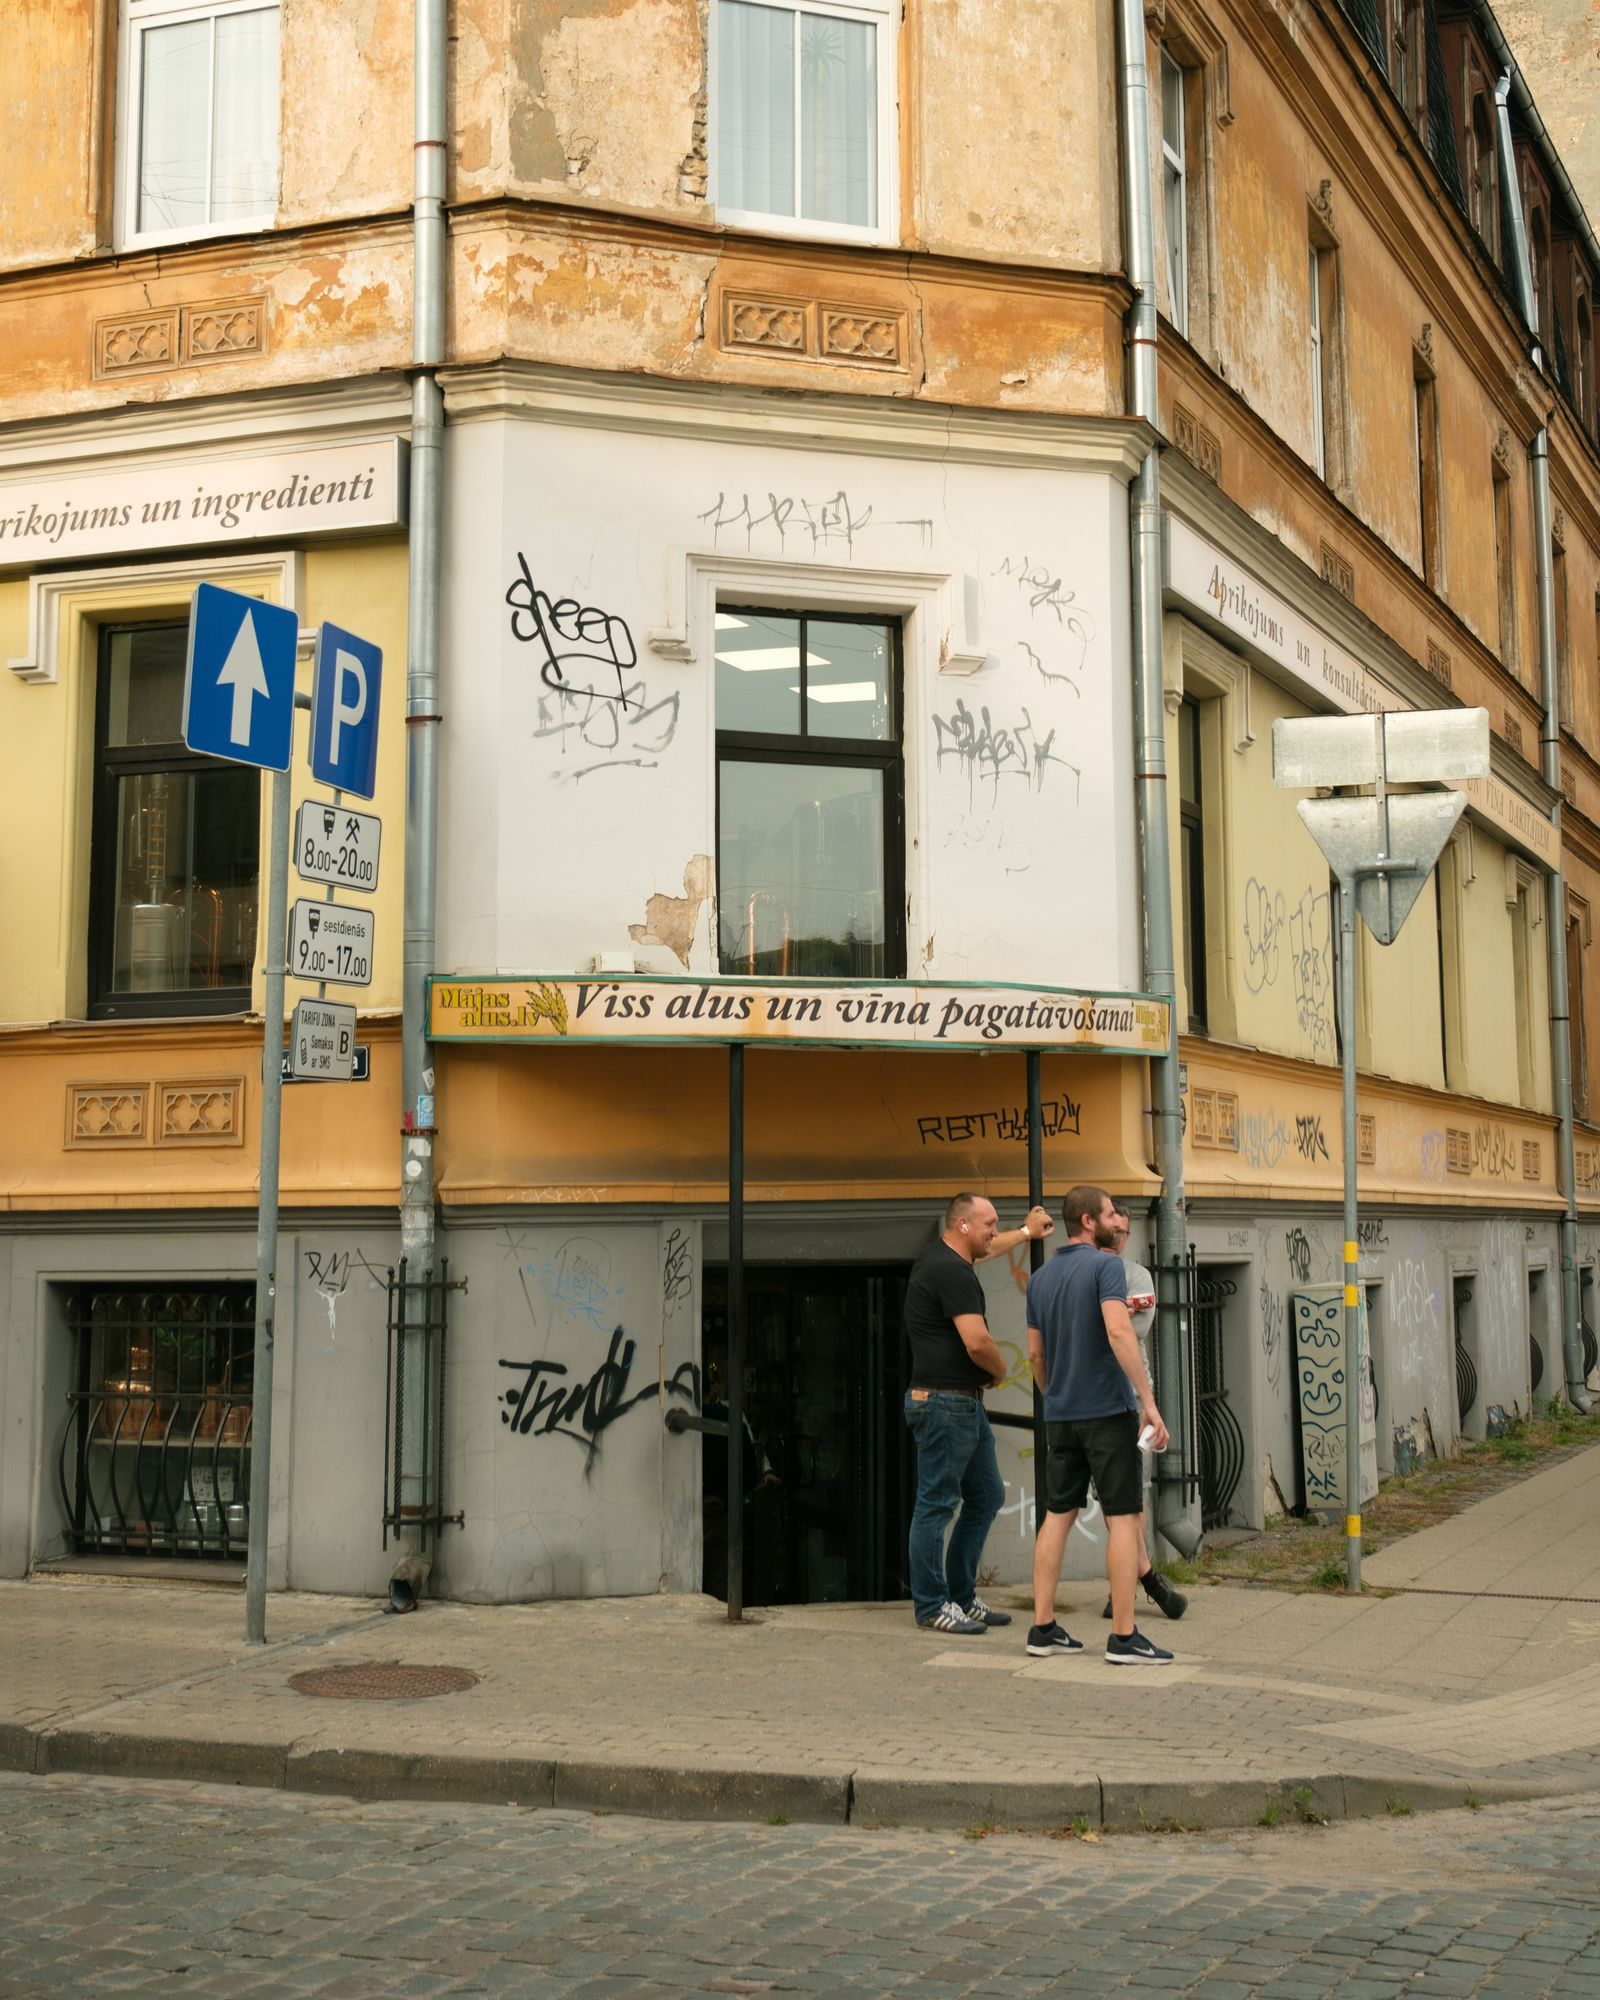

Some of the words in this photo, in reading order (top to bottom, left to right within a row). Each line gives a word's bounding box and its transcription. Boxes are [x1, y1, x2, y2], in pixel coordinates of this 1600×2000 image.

[0, 501, 132, 543] rīkojums
[141, 499, 181, 524] un
[191, 467, 375, 528] ingredienti
[1296, 639, 1310, 667] un
[1322, 648, 1384, 713] konsultācij
[329, 647, 368, 766] P
[323, 920, 366, 938] sestdienās
[439, 987, 510, 1012] Mājas
[575, 983, 654, 1019] Viss
[664, 984, 754, 1021] alus
[766, 997, 822, 1022] un
[836, 992, 930, 1025] vīna
[932, 997, 1135, 1040] pagatavošanai
[301, 1010, 321, 1027] TARIFU
[322, 1012, 336, 1028] ZONA
[310, 1035, 334, 1050] Samaksa
[340, 1031, 349, 1055] B
[319, 1055, 331, 1069] SMS
